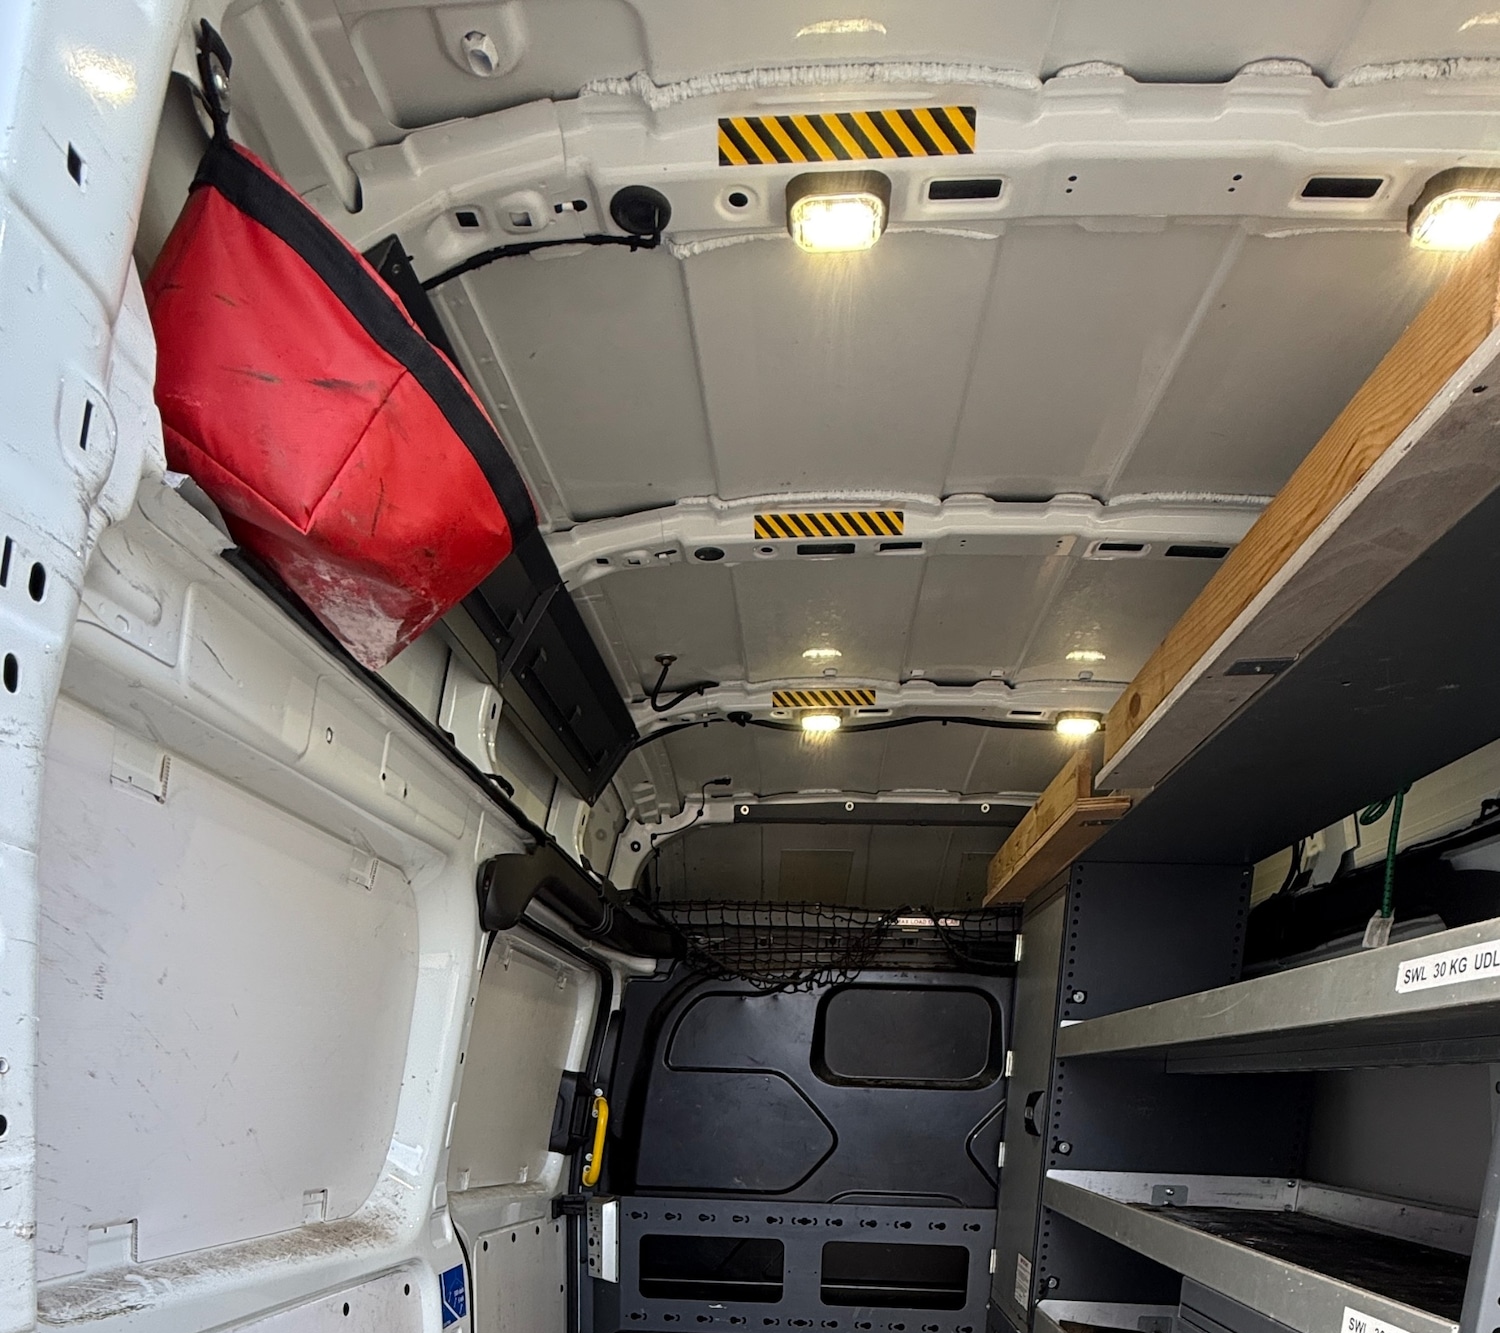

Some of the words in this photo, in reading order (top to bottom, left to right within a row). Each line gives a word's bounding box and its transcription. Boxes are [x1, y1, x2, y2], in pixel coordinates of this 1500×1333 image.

[1404, 966, 1427, 984] SWL
[1433, 961, 1446, 978] 30
[1449, 957, 1467, 975] KG
[1474, 950, 1500, 970] UDL
